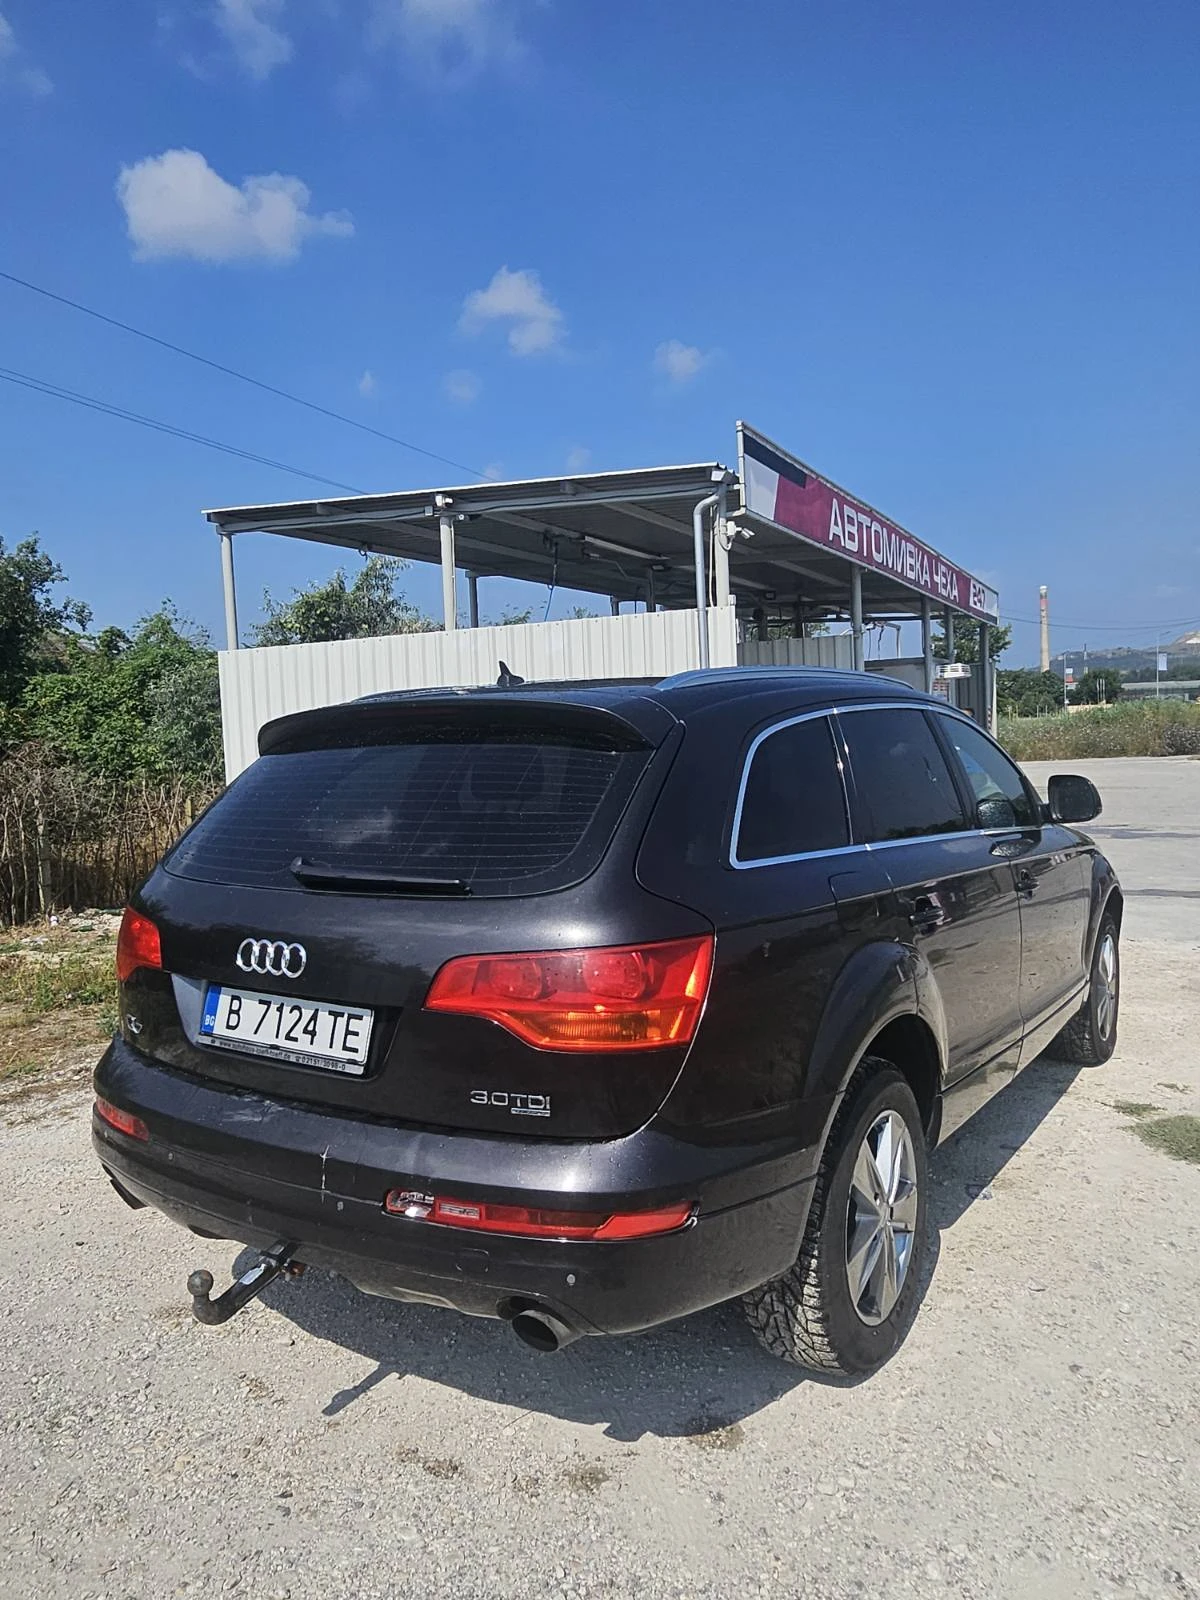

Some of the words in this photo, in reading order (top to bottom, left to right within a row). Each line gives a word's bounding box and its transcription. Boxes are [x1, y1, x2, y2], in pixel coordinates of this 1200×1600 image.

[829, 498, 931, 589] АВТОМИВКА
[933, 559, 960, 604] ЧЕХА
[204, 1014, 216, 1027] BG
[225, 995, 242, 1031] B
